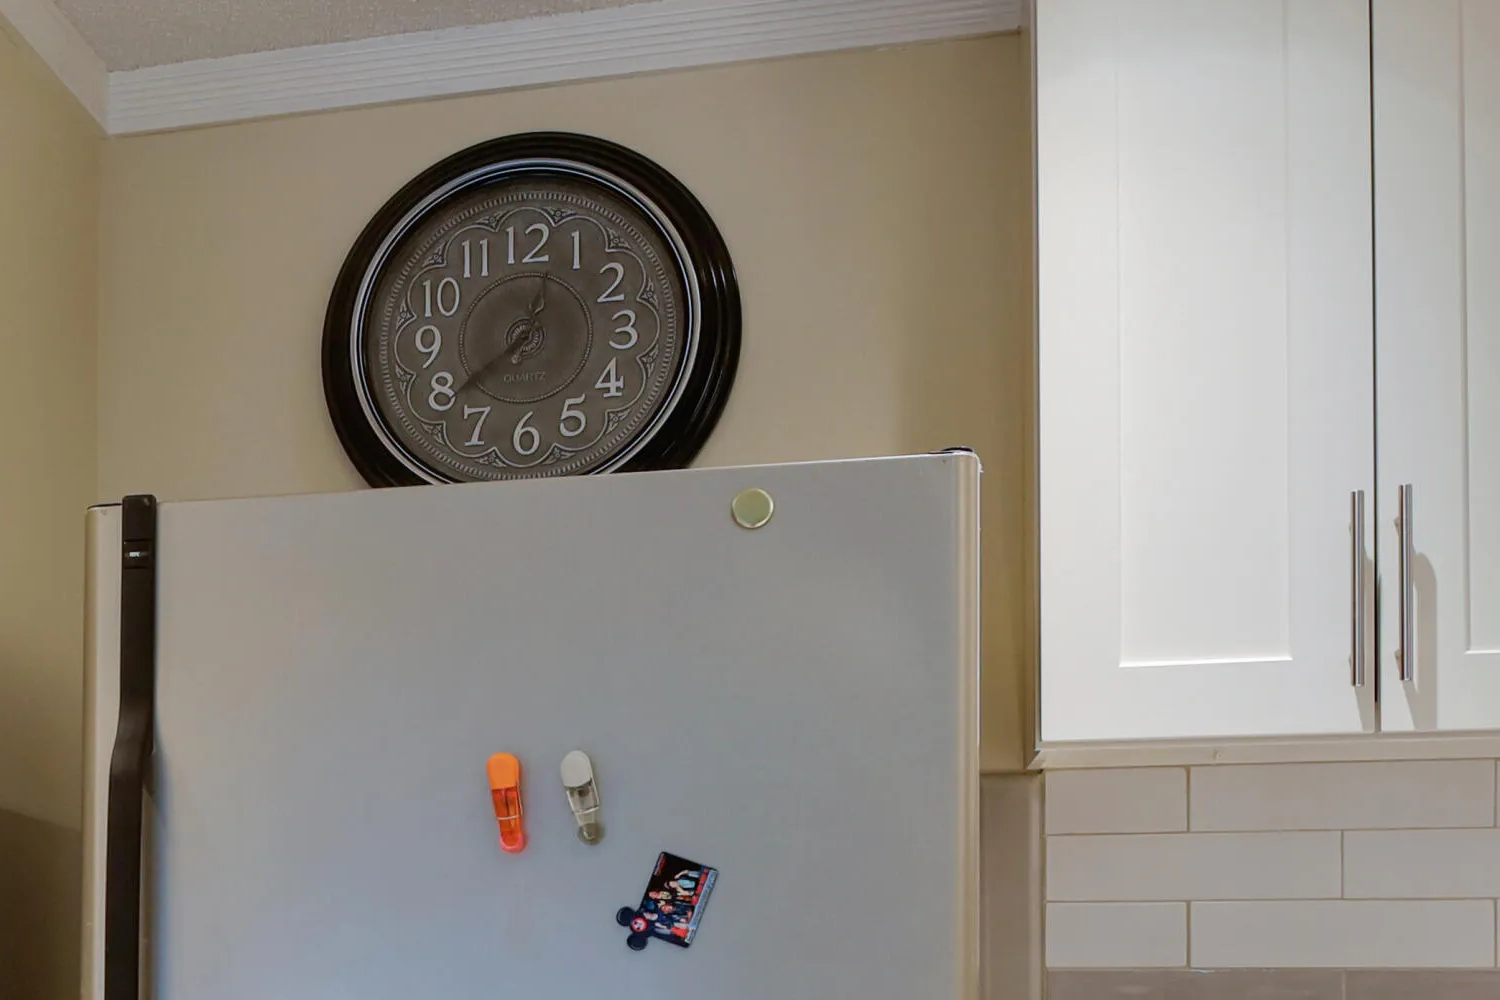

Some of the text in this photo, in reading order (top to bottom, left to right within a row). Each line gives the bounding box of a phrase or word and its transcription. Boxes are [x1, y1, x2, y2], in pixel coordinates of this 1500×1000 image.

[462, 238, 489, 279] 11
[506, 223, 550, 265] 12
[571, 229, 581, 270] 1
[422, 276, 460, 318] 10
[597, 262, 625, 302] 2
[415, 325, 442, 369] 9
[608, 309, 638, 350] 3
[428, 371, 456, 412] 8
[503, 371, 546, 384] QUARTZ
[595, 356, 624, 398] 4
[463, 404, 492, 446] 7
[513, 411, 540, 455] 6
[559, 393, 587, 437] 5
